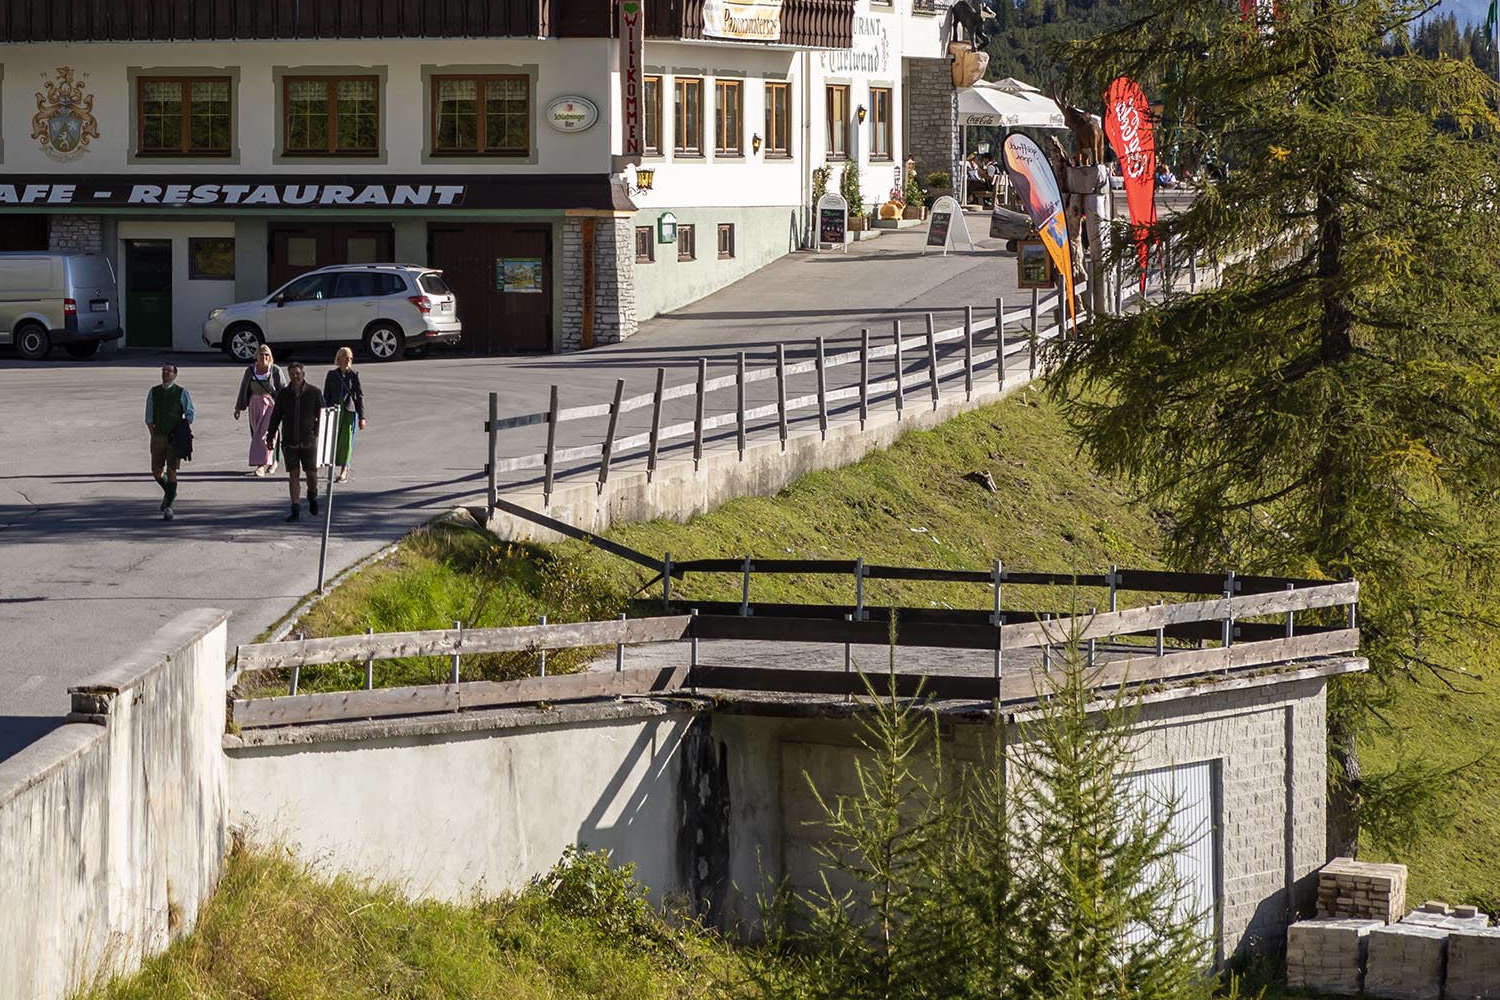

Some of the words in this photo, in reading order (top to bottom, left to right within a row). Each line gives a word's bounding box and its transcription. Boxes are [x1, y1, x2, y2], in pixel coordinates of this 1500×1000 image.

[853, 16, 881, 37] URANT
[623, 12, 639, 153] WILLKOMMEN
[966, 114, 994, 126] Coca-Cola
[126, 184, 466, 205] RESTAURANT
